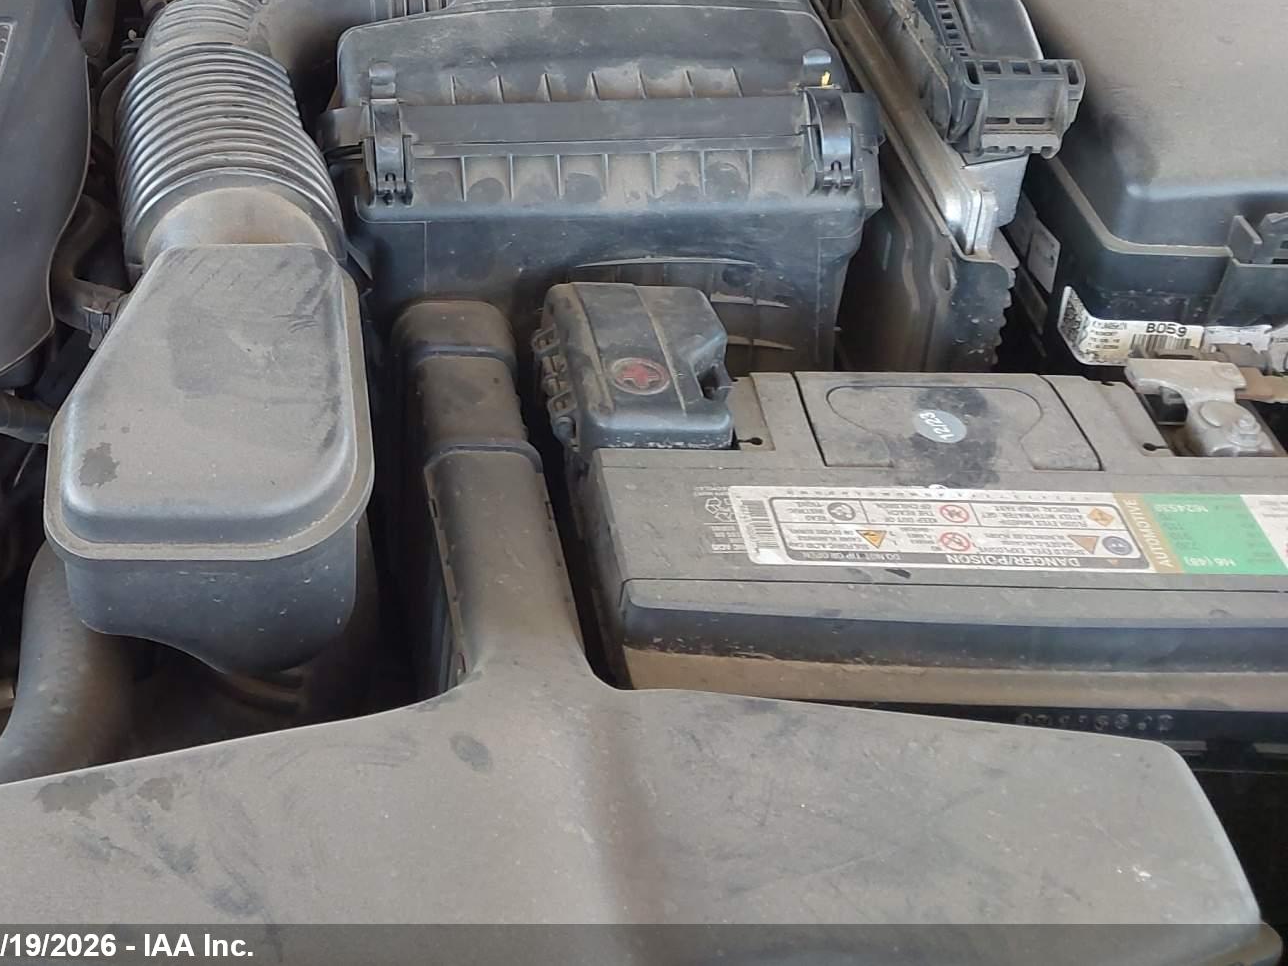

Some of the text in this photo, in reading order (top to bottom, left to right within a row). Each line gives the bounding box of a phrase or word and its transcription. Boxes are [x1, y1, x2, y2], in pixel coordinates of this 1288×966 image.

[919, 412, 955, 440] 12/23
[1122, 498, 1175, 568] AUTOMOTIVE
[945, 554, 1081, 567] DANGER/POISON
